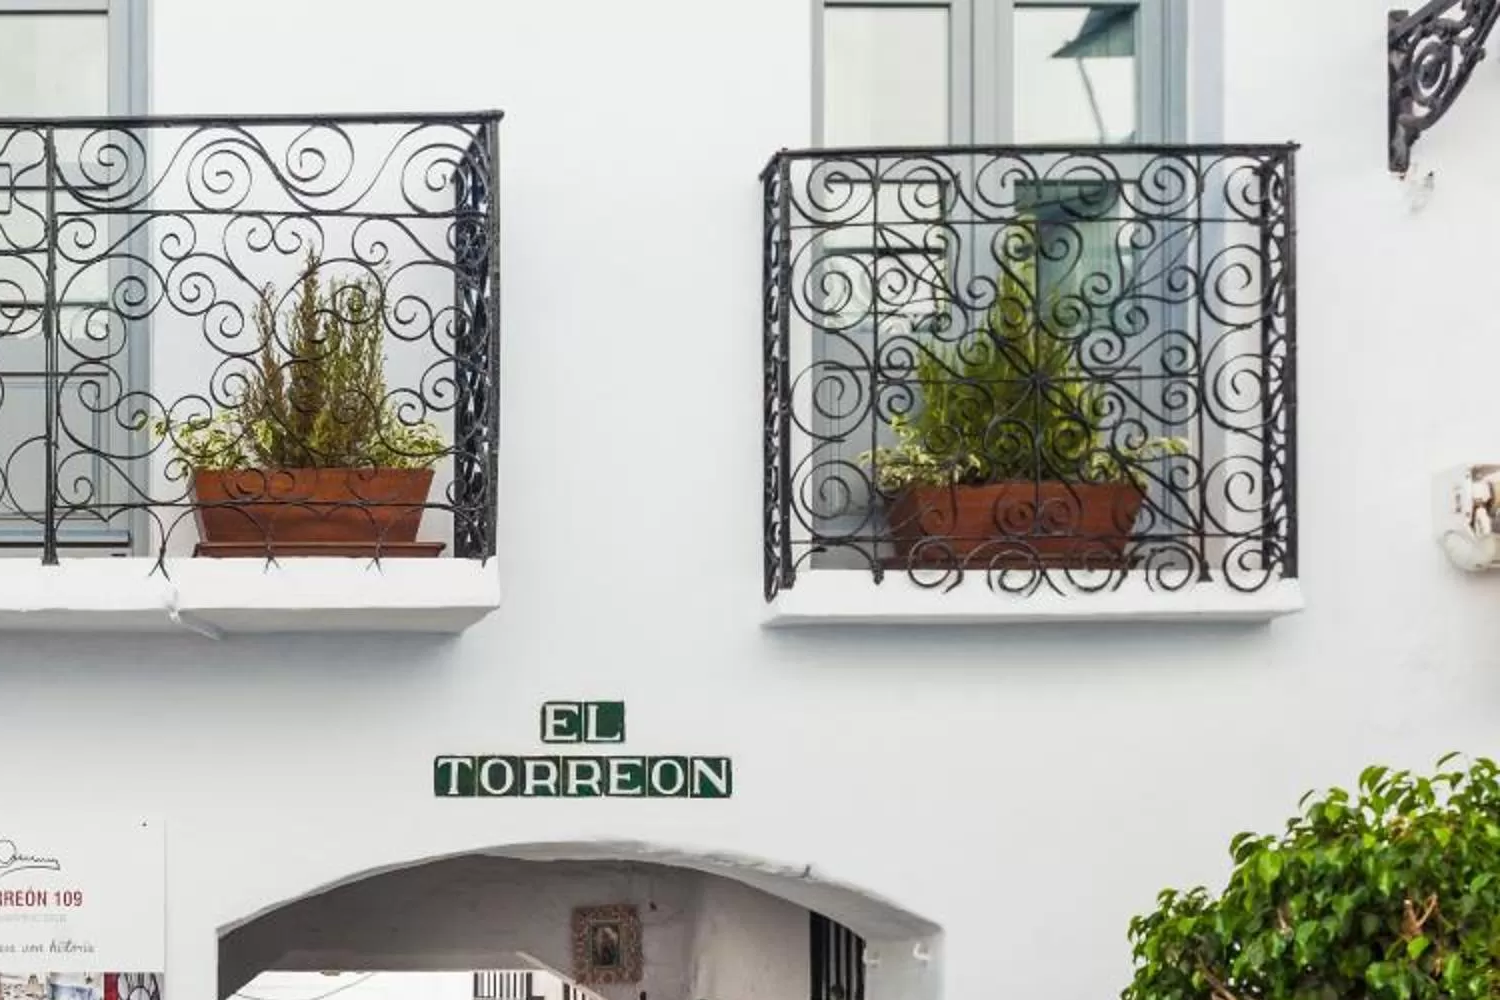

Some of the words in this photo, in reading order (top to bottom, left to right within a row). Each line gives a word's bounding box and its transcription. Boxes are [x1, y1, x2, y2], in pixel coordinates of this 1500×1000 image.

[543, 703, 621, 741] EL
[436, 758, 729, 796] TORREON
[54, 890, 83, 907] 109
